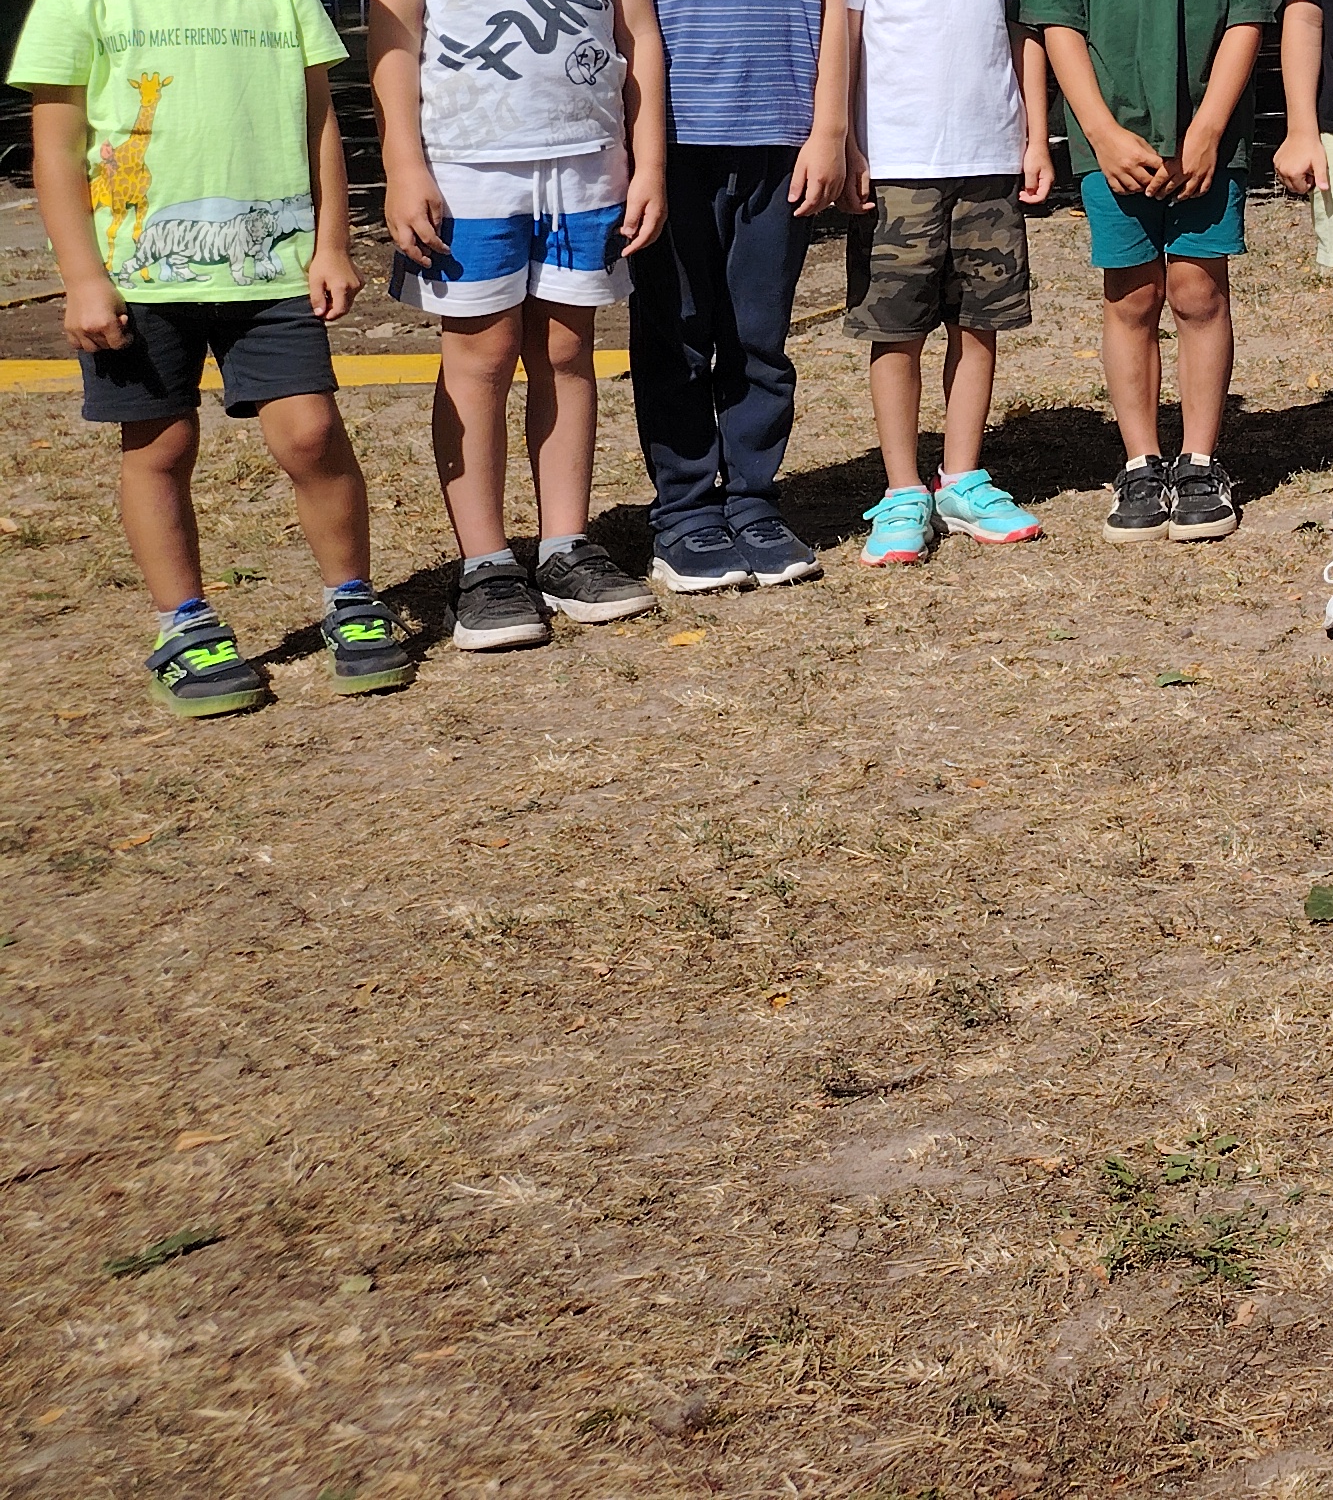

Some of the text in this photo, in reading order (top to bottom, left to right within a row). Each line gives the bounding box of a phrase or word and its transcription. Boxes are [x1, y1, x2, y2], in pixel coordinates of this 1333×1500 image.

[149, 28, 181, 48] MAKE
[184, 28, 227, 47] FRIENDS
[230, 29, 256, 48] WITH
